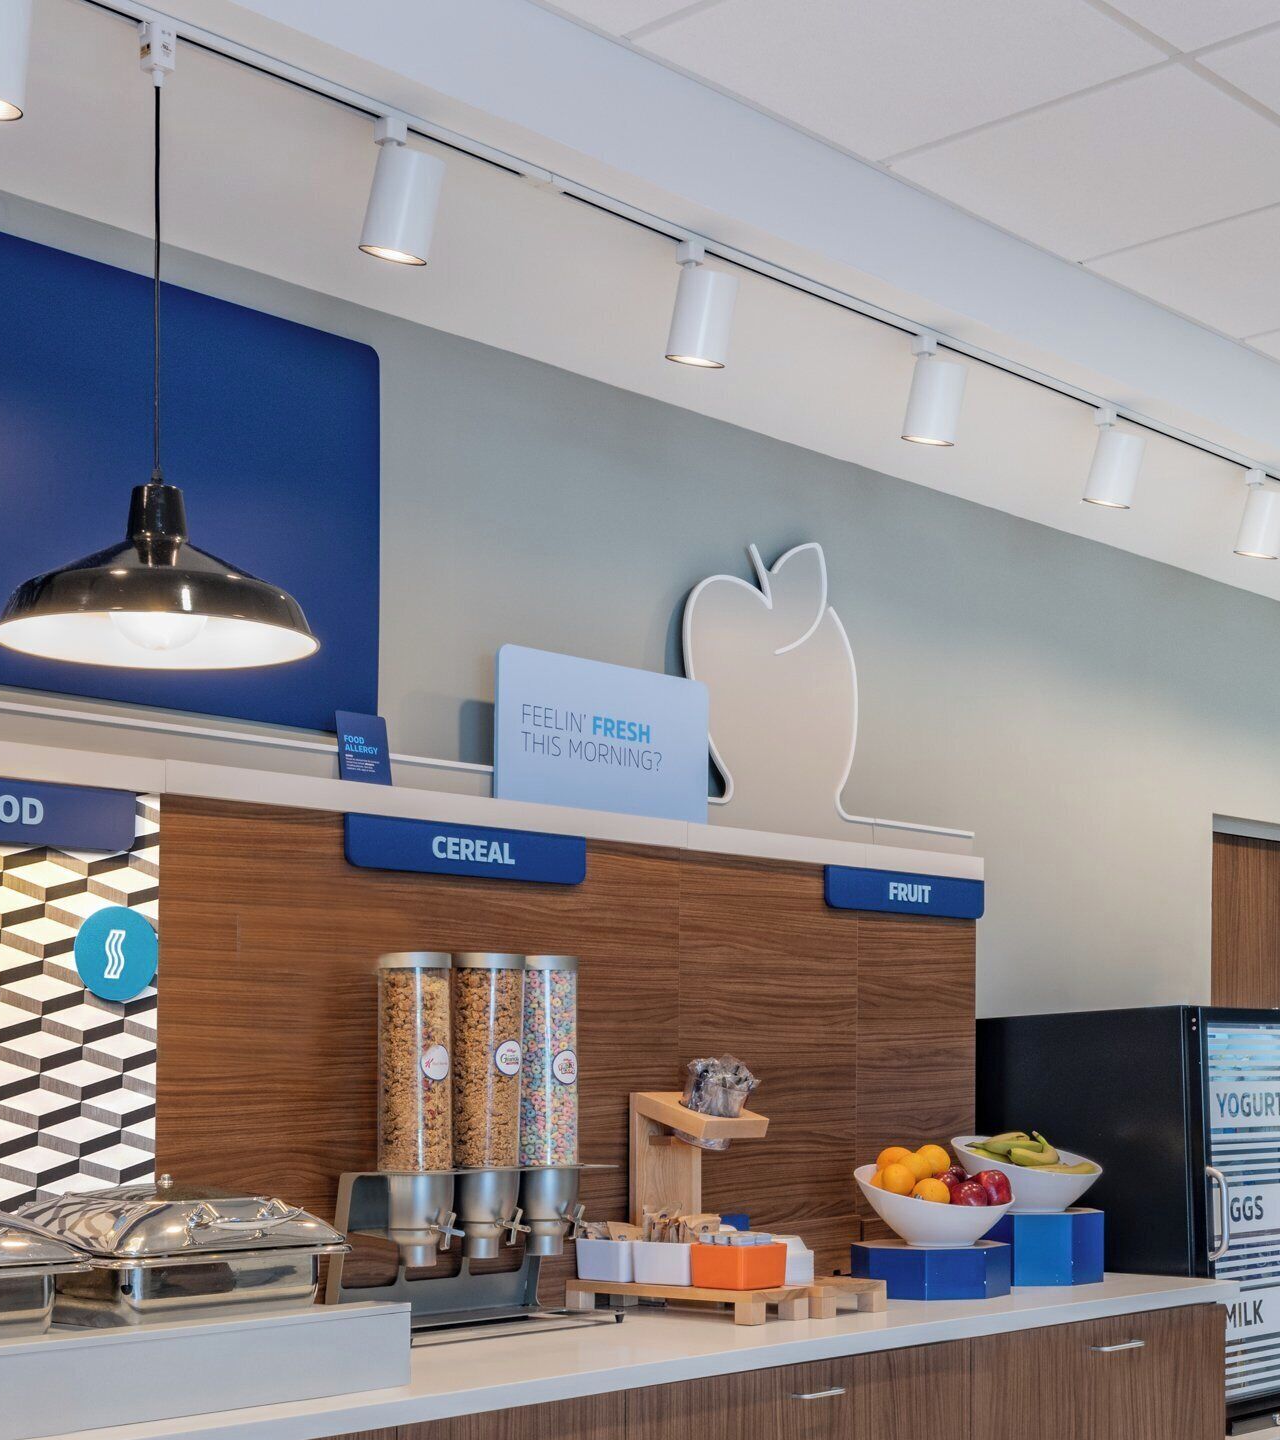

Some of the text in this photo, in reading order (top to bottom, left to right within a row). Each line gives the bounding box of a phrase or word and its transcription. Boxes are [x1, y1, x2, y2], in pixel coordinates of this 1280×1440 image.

[343, 735, 365, 745] FOOD
[591, 715, 652, 745] FRESH
[344, 744, 379, 755] ALLERGY
[521, 731, 663, 772] THIS MORNING?
[431, 835, 516, 865] CEREAL
[888, 881, 932, 904] FRUIT
[1229, 1195, 1264, 1223] GGS
[1225, 1298, 1265, 1329] MILK
